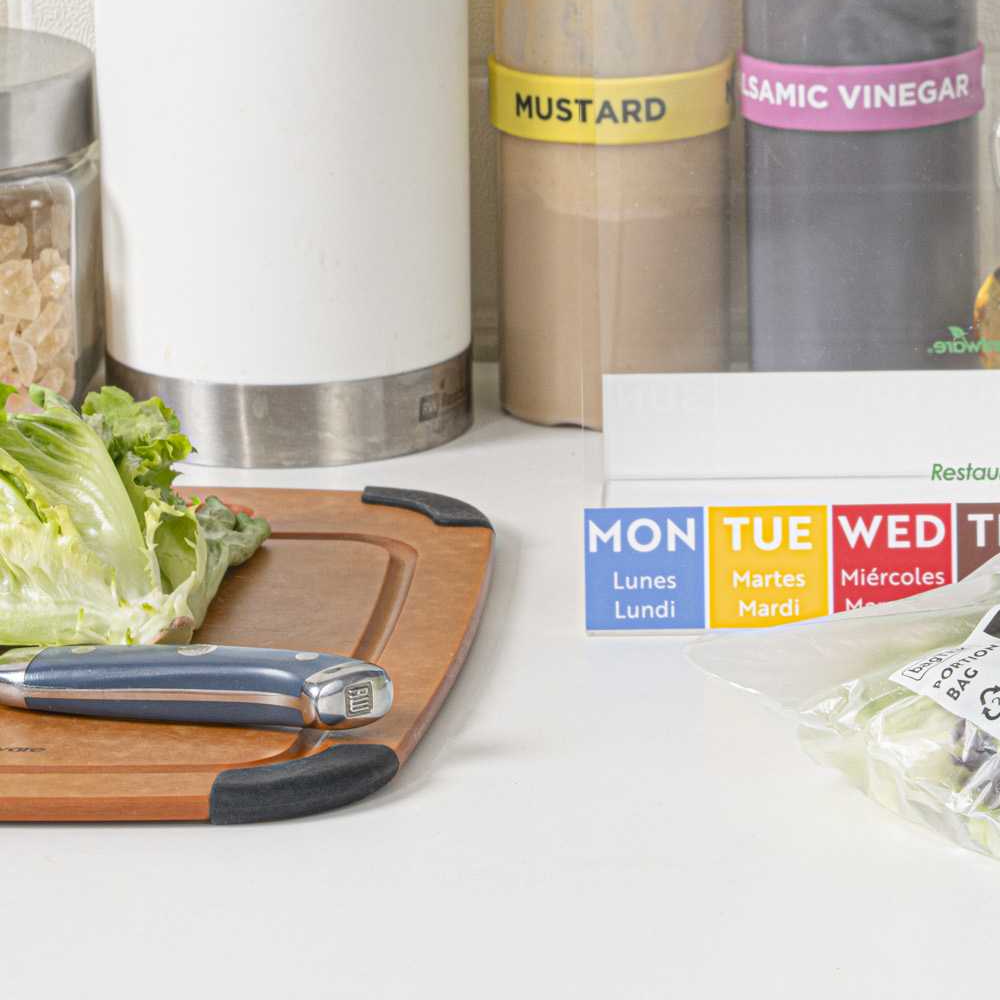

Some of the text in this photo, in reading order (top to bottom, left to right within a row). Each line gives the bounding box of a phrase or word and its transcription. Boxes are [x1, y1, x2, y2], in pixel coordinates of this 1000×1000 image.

[514, 92, 667, 124] MUSTARD
[837, 73, 969, 110] VINEGAR
[588, 517, 696, 553] MON
[722, 515, 813, 551] TUE
[836, 513, 946, 549] WED
[613, 571, 677, 590] Lunes
[732, 569, 806, 588] Martes
[841, 567, 945, 586] Miércoles
[615, 600, 676, 619] Lundi
[738, 599, 800, 617] Mardi
[932, 643, 1000, 689] PORTION
[946, 666, 979, 701] BAG
